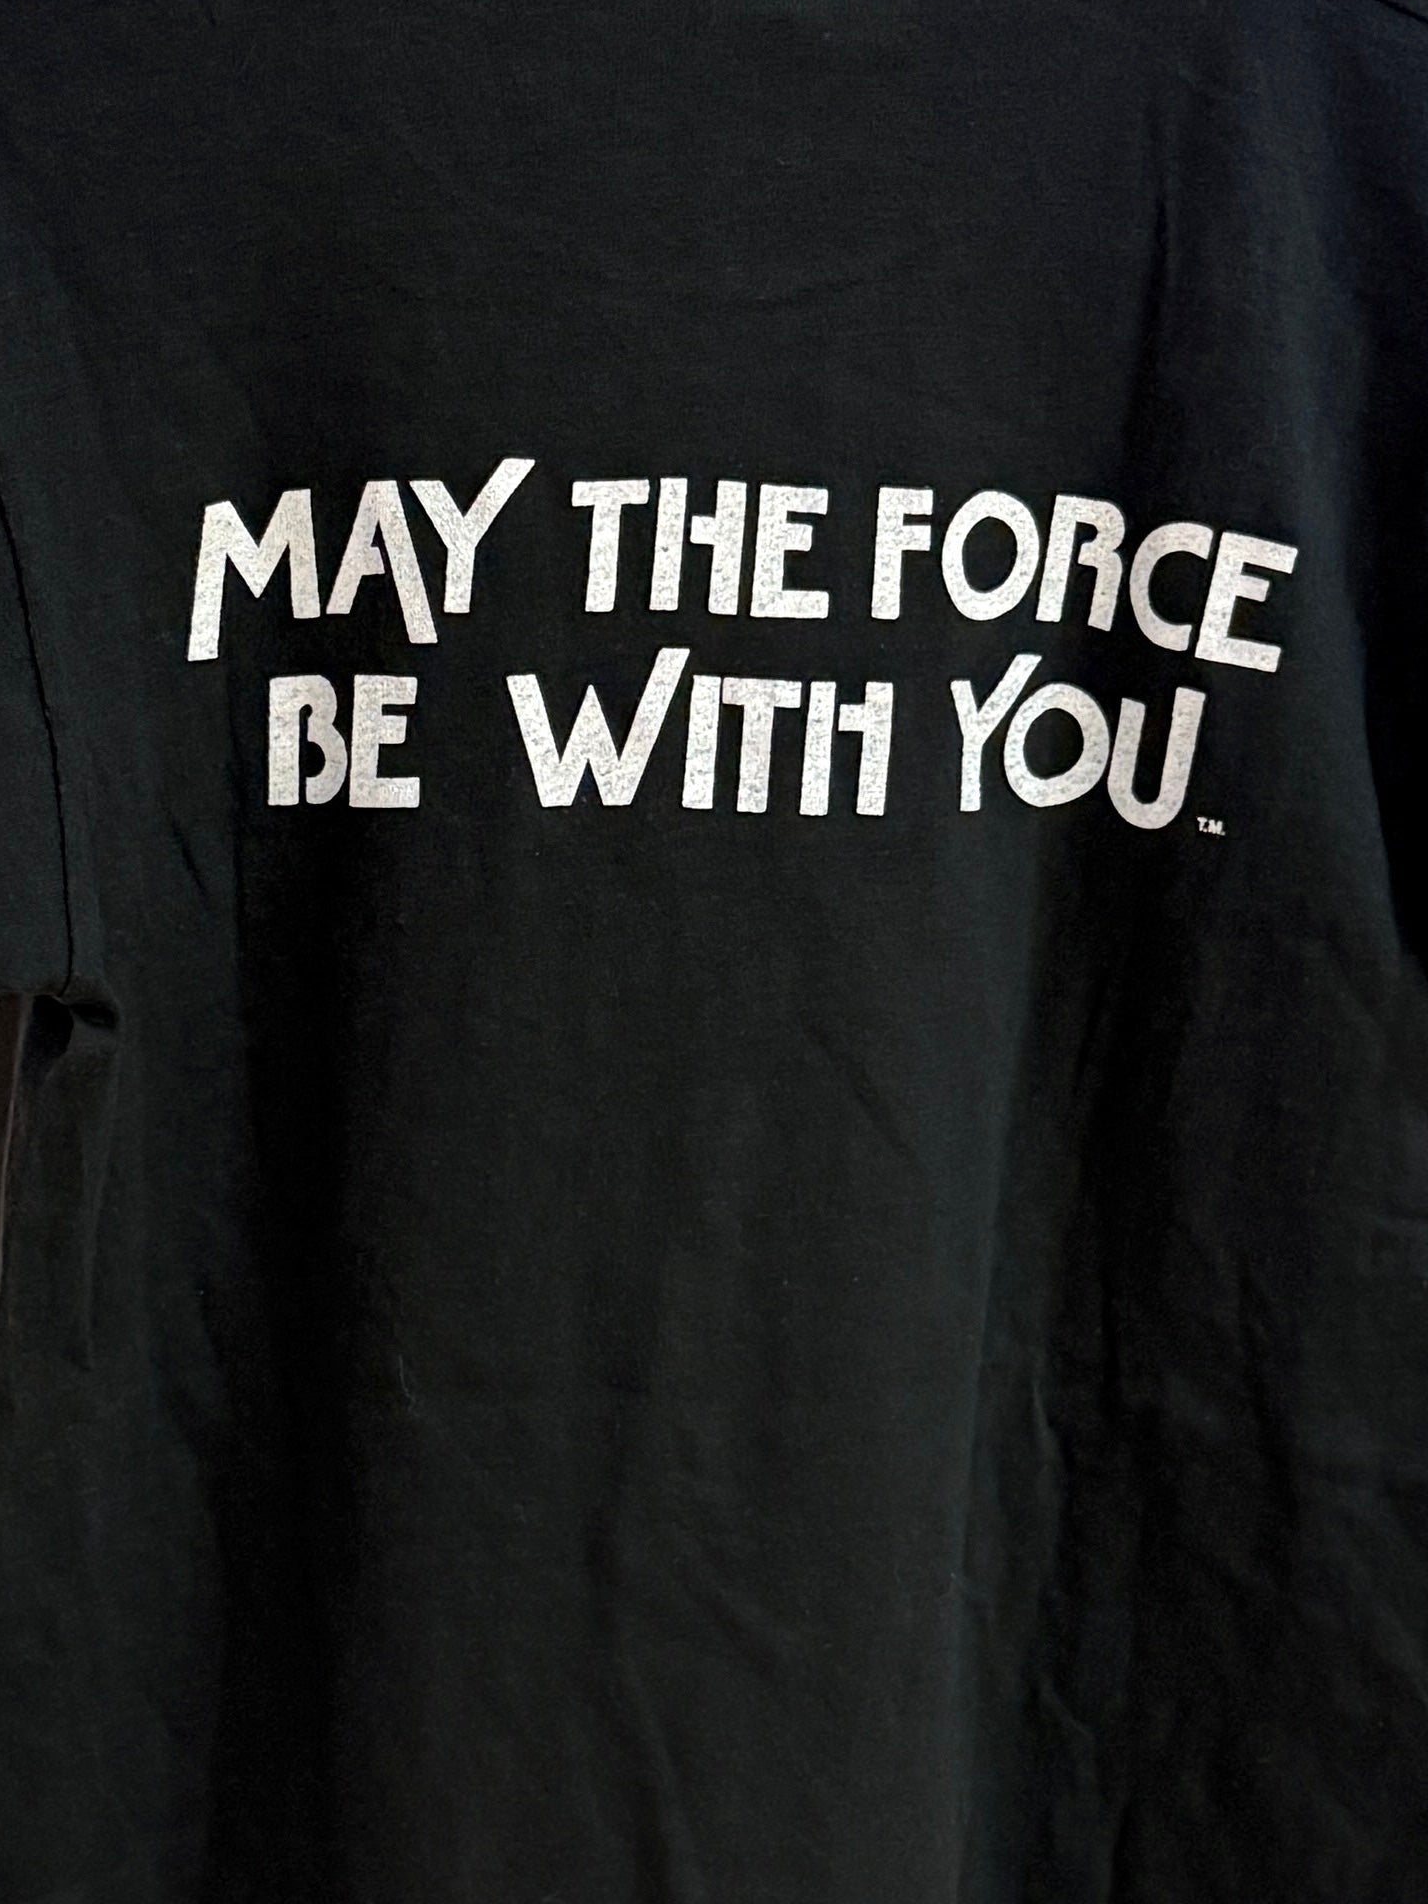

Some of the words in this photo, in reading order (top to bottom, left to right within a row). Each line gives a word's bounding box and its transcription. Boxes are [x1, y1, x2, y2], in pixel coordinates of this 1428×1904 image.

[186, 457, 536, 662] MAY
[571, 477, 830, 620] THE
[871, 486, 1299, 674] FORCE
[267, 674, 421, 809] BE
[505, 647, 894, 817] WITH
[950, 653, 1206, 830] YOU
